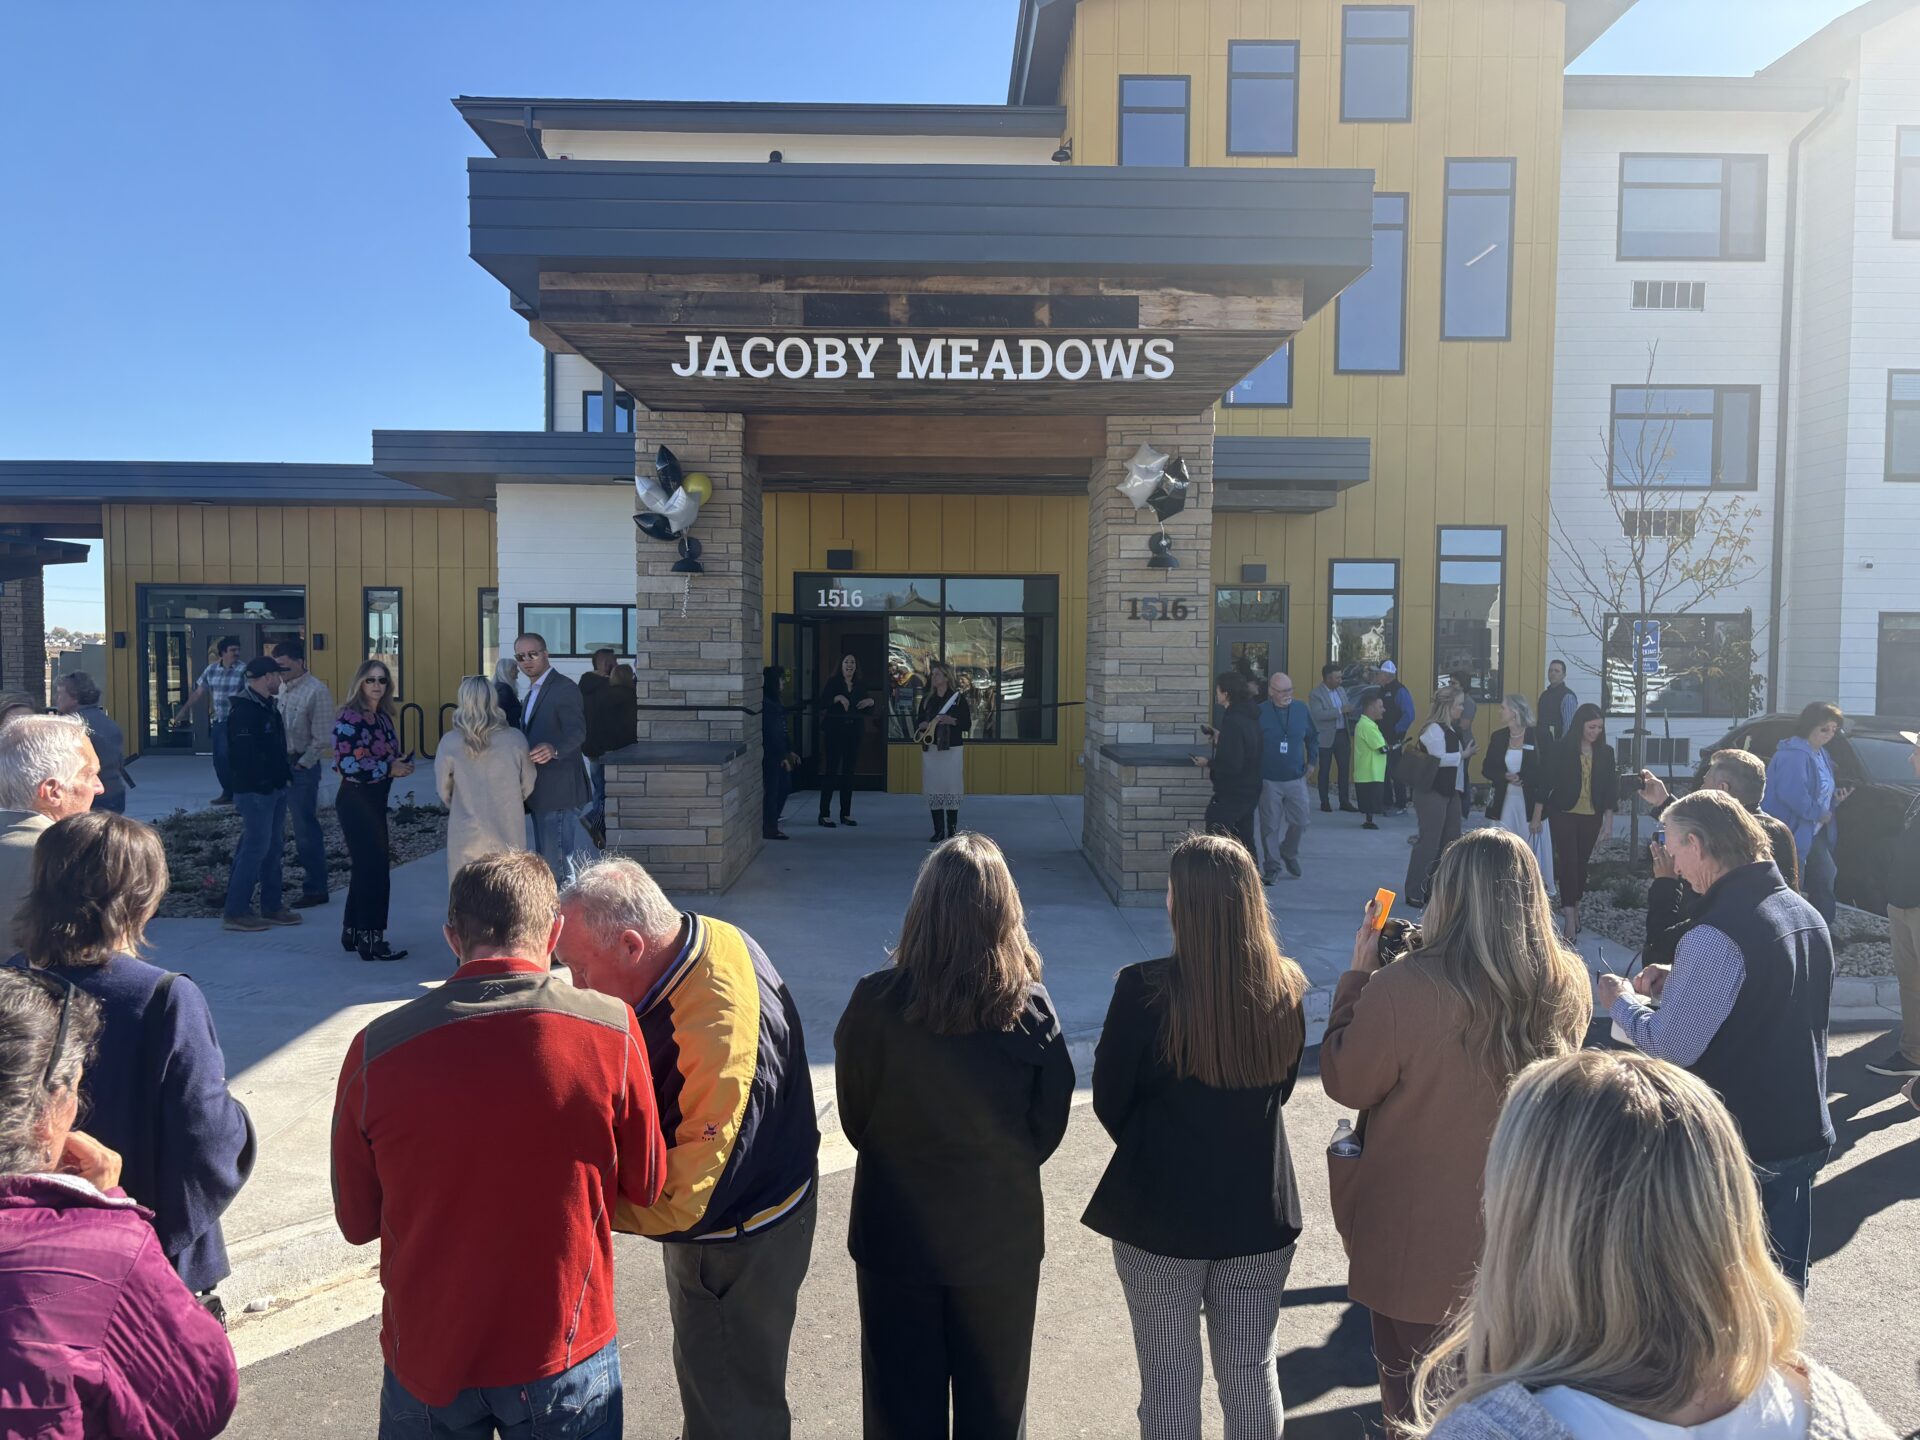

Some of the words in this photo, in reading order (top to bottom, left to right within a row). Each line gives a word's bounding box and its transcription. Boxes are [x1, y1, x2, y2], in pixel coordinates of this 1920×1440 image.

[671, 335, 883, 379] JACOBY
[897, 338, 1175, 380] MEADOWS
[817, 589, 863, 608] 1516
[1127, 597, 1189, 621] 1516
